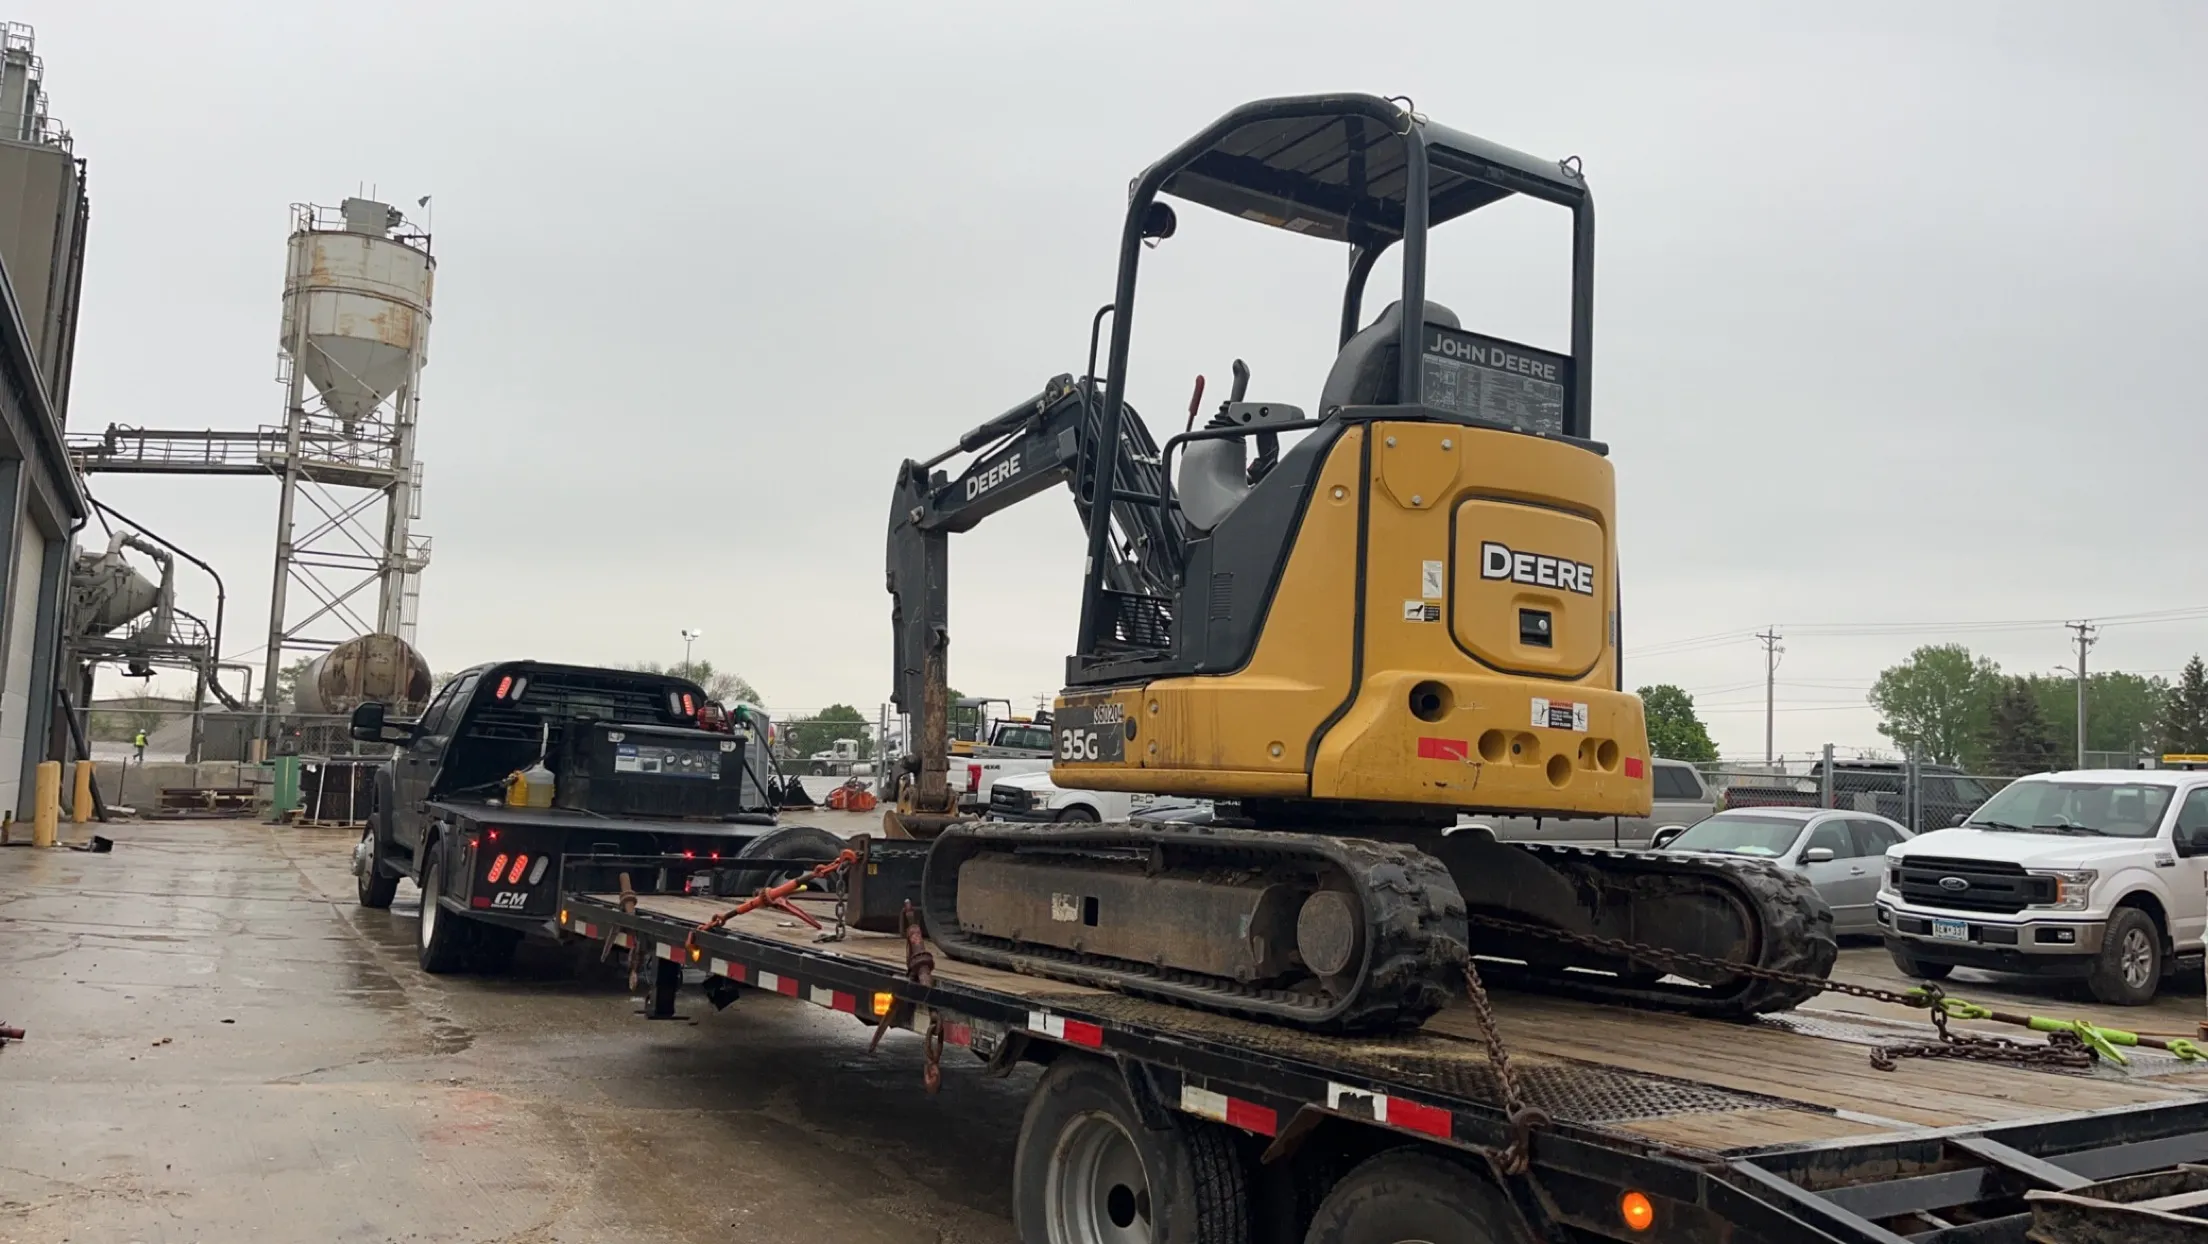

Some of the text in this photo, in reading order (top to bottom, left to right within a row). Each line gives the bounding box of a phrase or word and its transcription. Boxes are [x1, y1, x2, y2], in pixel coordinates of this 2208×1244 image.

[1430, 333, 1557, 381] JOHN DEERE
[966, 453, 1021, 501] DEERE
[1482, 542, 1593, 595] DEERE
[1061, 729, 1099, 760] 35G
